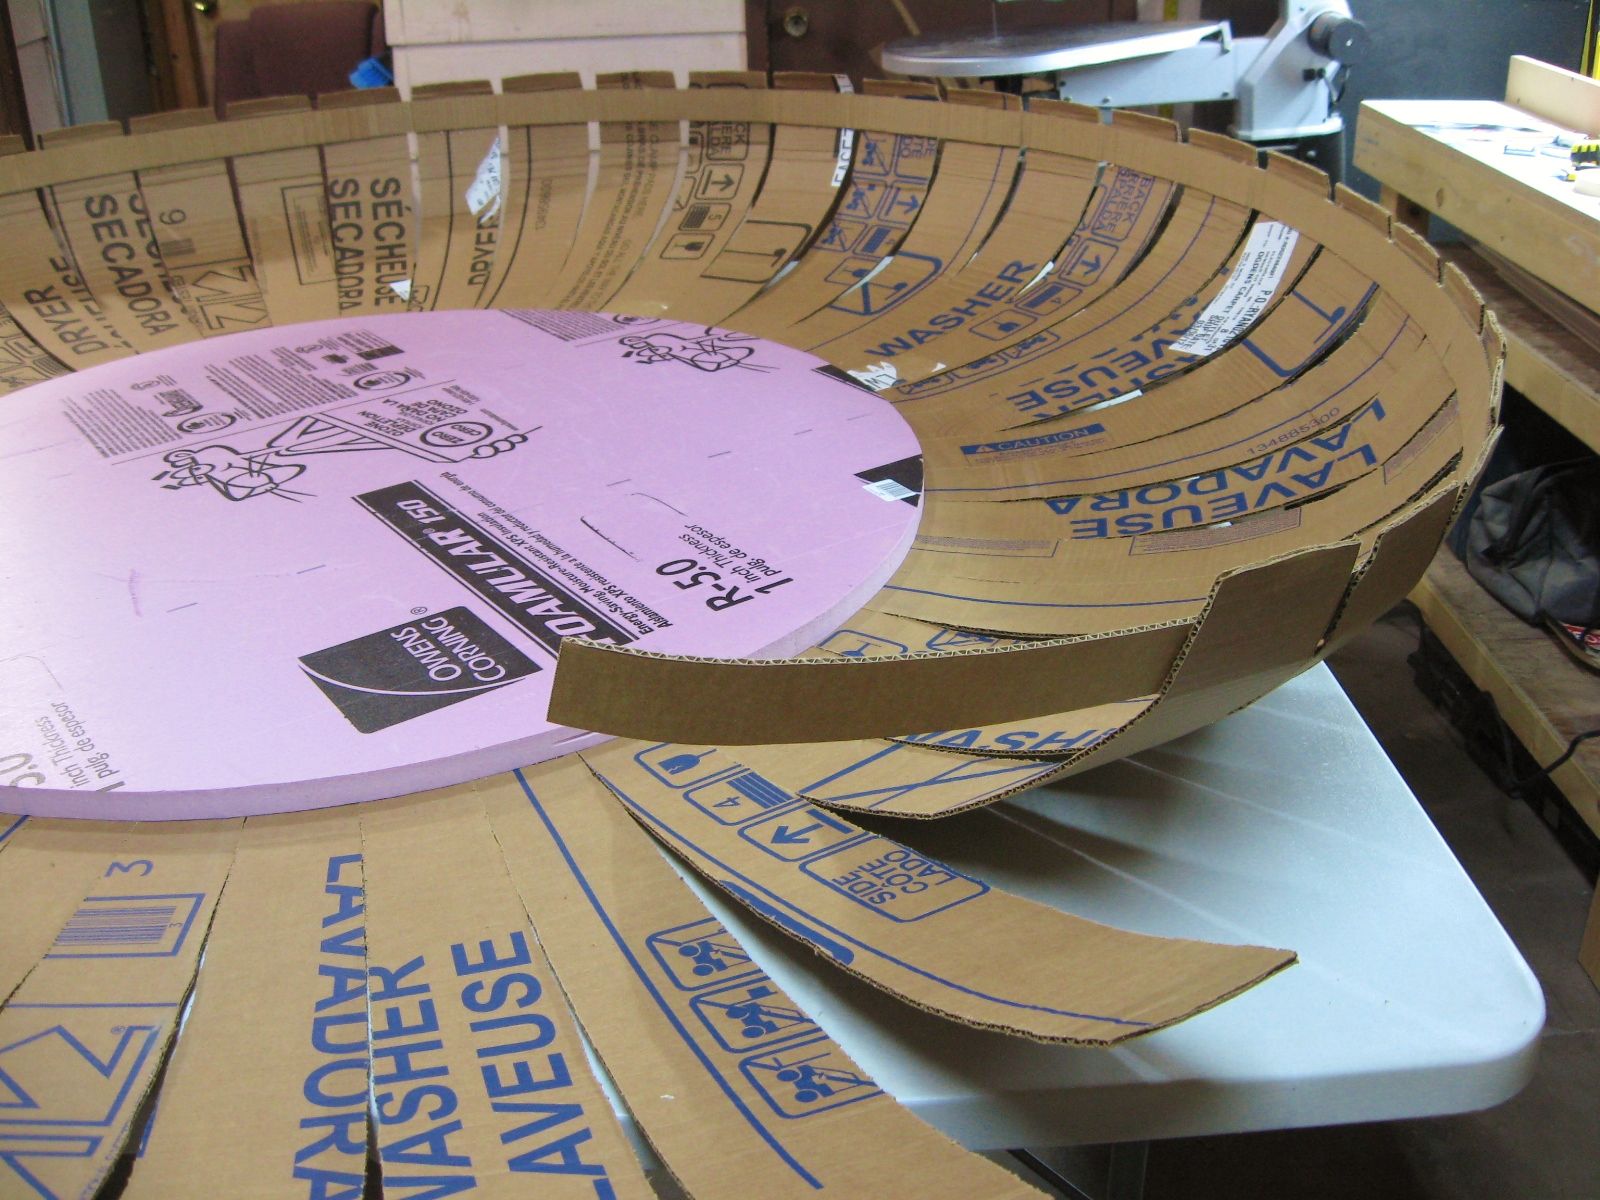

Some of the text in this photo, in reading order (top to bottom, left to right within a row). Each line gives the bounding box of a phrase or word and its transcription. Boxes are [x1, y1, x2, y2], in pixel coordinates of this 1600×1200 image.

[84, 194, 179, 336] SECADORA
[329, 178, 364, 311] SECADORA
[23, 284, 110, 355] DRYER
[864, 260, 1037, 357] WASHER
[997, 427, 1090, 450] CAUTION
[1044, 399, 1387, 515] LAVADORA
[456, 484, 472, 492] de
[465, 489, 497, 508] consumo
[1069, 443, 1379, 538] LAVEUSE
[394, 497, 446, 524] 150
[487, 506, 506, 515] del
[496, 512, 531, 533] reductor
[526, 532, 565, 556] humedad
[677, 532, 761, 584] inch Thickness
[684, 523, 782, 577] pulg. de espesor
[473, 511, 654, 636] Energy-Saving, Moisture-Resistant XPS Insulation
[569, 561, 611, 587] resistente
[601, 583, 629, 599] XPS
[656, 558, 740, 613] R-5.0
[753, 576, 793, 594] 1
[618, 595, 673, 630] Aislamiento
[389, 626, 461, 681] OWENS
[420, 616, 505, 680] CORNING
[35, 716, 90, 789] inch Thickness
[51, 702, 120, 779] pulg. de espesor
[712, 796, 741, 808] 4
[106, 858, 153, 879] 3
[832, 872, 897, 905] SIDE
[883, 850, 961, 886] LADO
[292, 853, 372, 1200] LAVADORA
